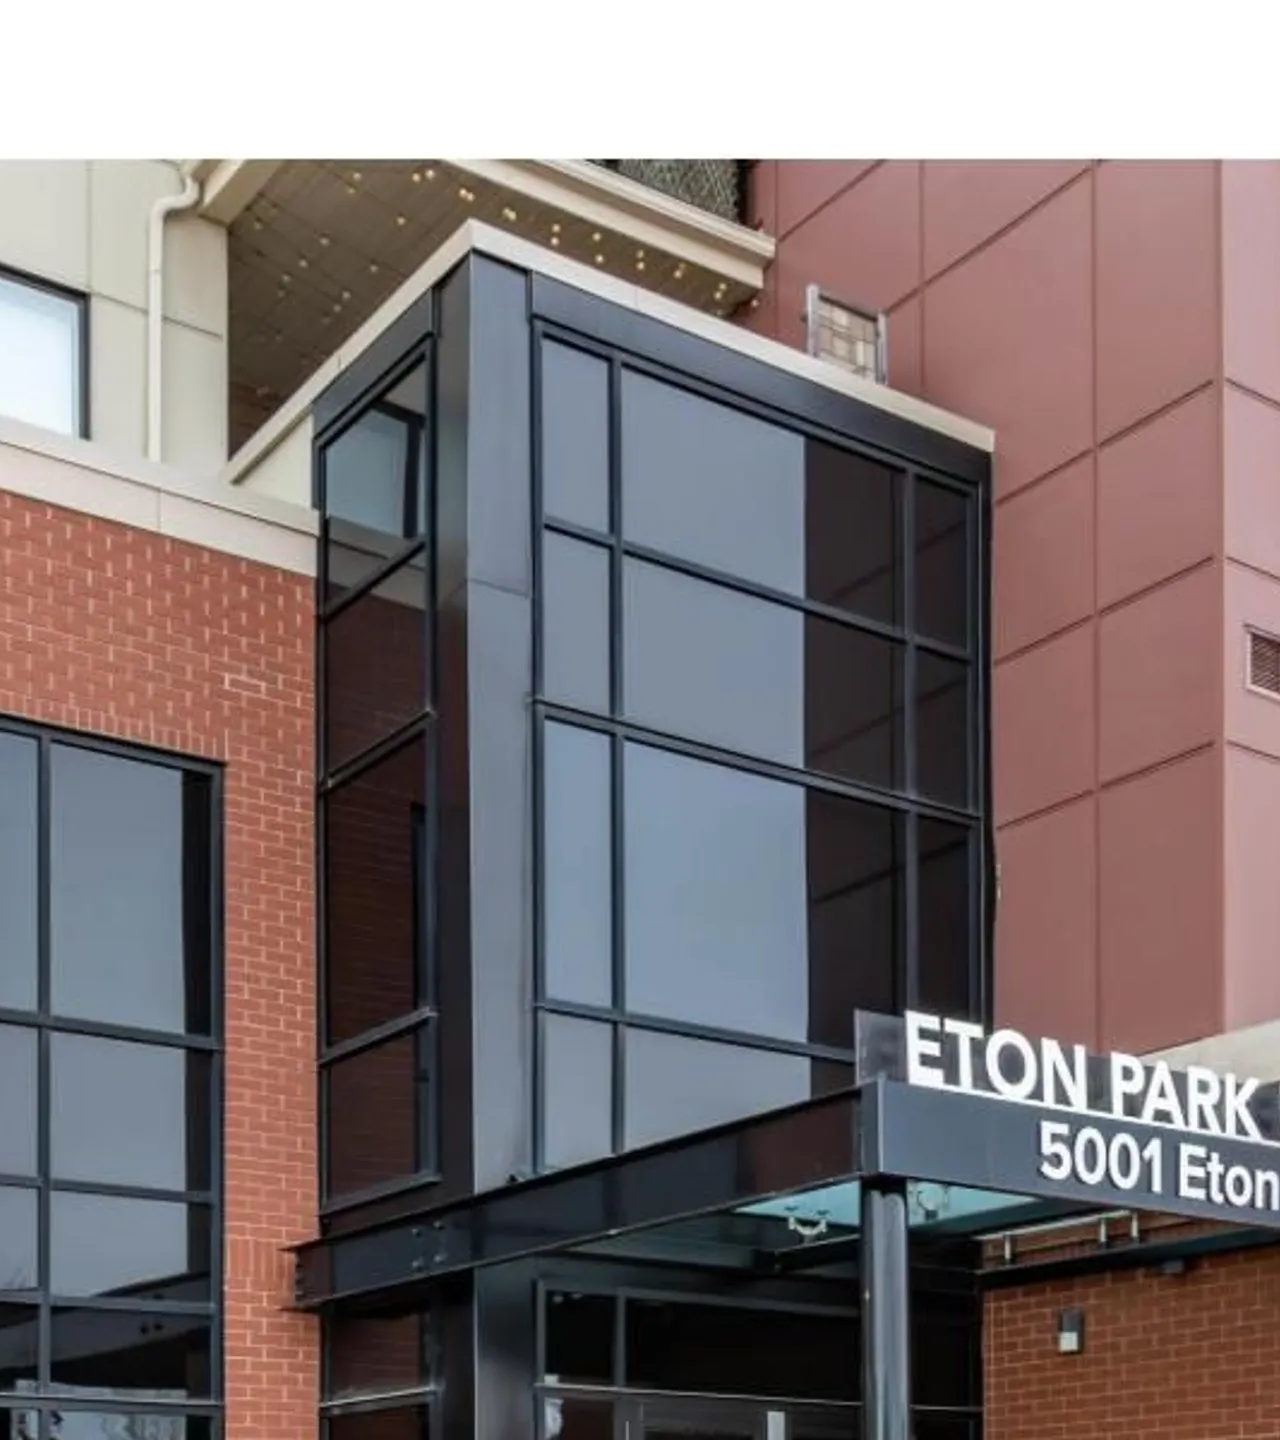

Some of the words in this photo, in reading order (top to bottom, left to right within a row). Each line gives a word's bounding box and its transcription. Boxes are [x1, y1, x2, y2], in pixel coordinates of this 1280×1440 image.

[904, 1010, 1088, 1113] ETON
[1110, 1051, 1261, 1142] PARK
[1039, 1121, 1163, 1193] 5001
[1179, 1143, 1280, 1211] Eton
